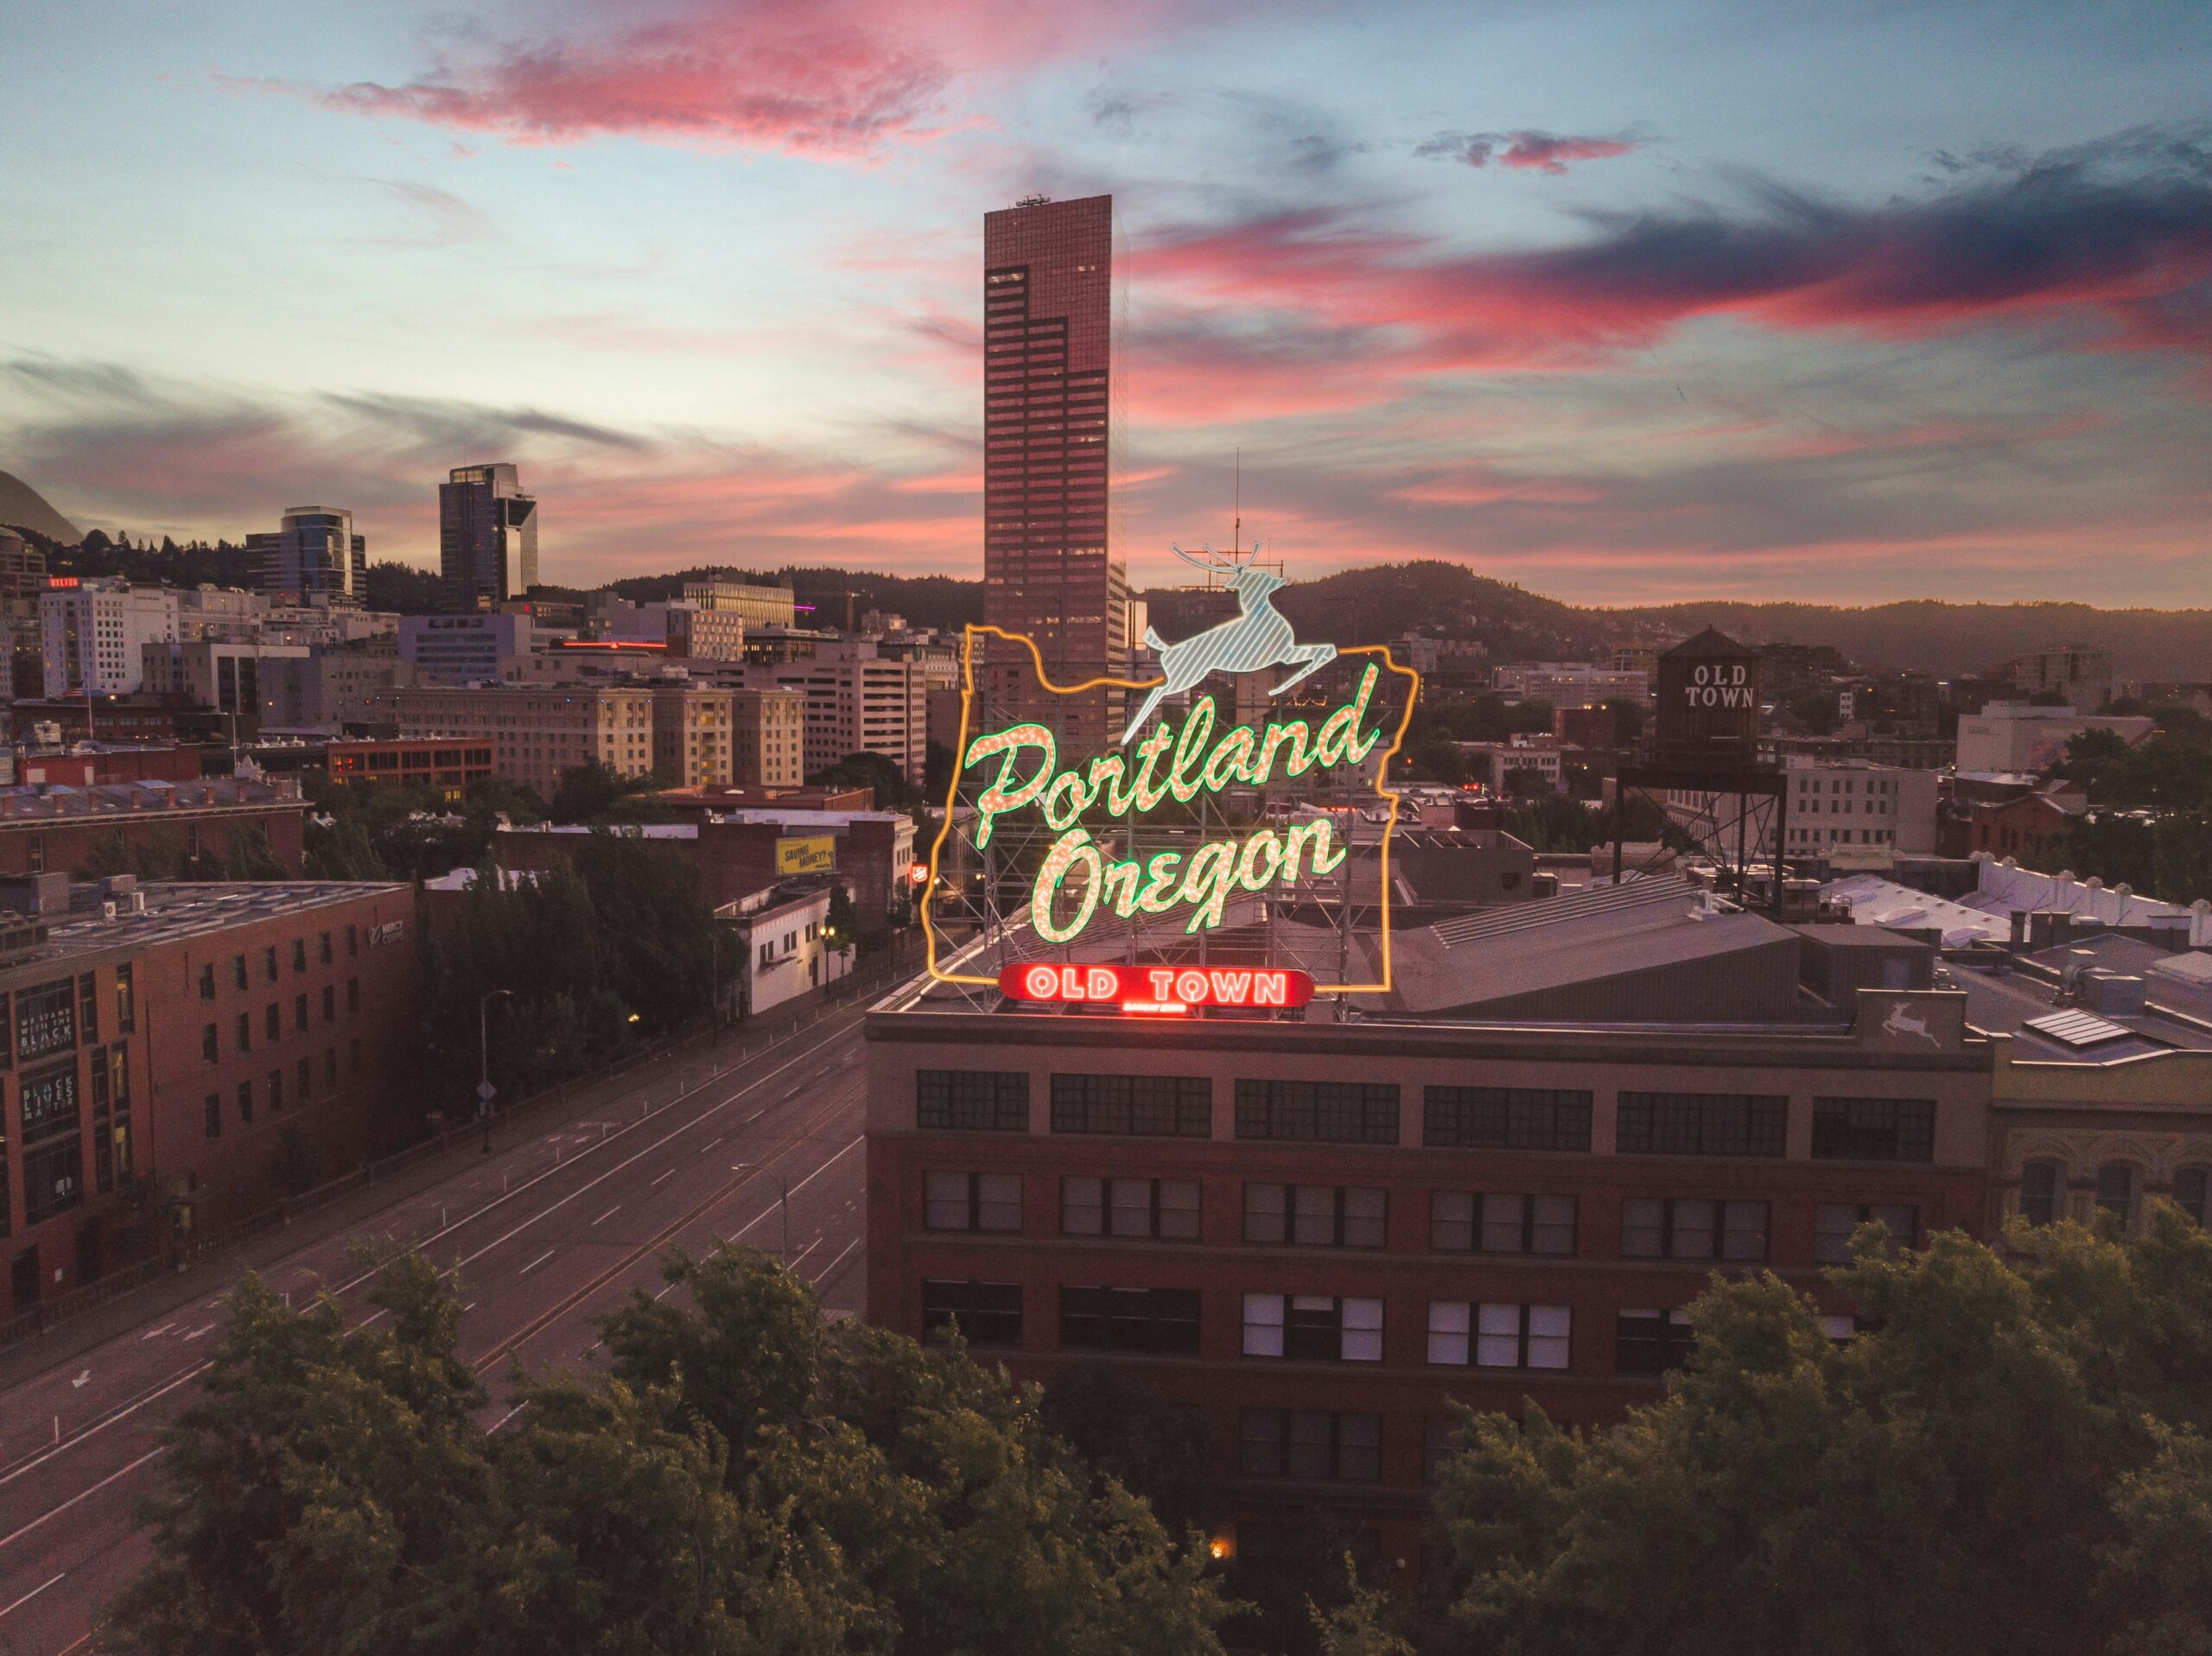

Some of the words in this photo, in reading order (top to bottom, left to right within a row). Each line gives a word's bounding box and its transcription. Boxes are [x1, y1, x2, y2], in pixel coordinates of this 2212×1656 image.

[1694, 664, 1746, 685] OLD
[1685, 687, 1754, 707] TOWN
[965, 663, 1380, 850] Portland
[785, 844, 810, 861] SAVING
[799, 850, 827, 868] MONEY?
[1032, 819, 1346, 943] Oregon
[382, 918, 404, 934] MERCY
[1027, 967, 1118, 999] OLD
[1149, 971, 1287, 1005] TOWN
[22, 1024, 71, 1047] BLACK
[23, 1075, 73, 1101] BLACK
[24, 1086, 73, 1112] LIVES
